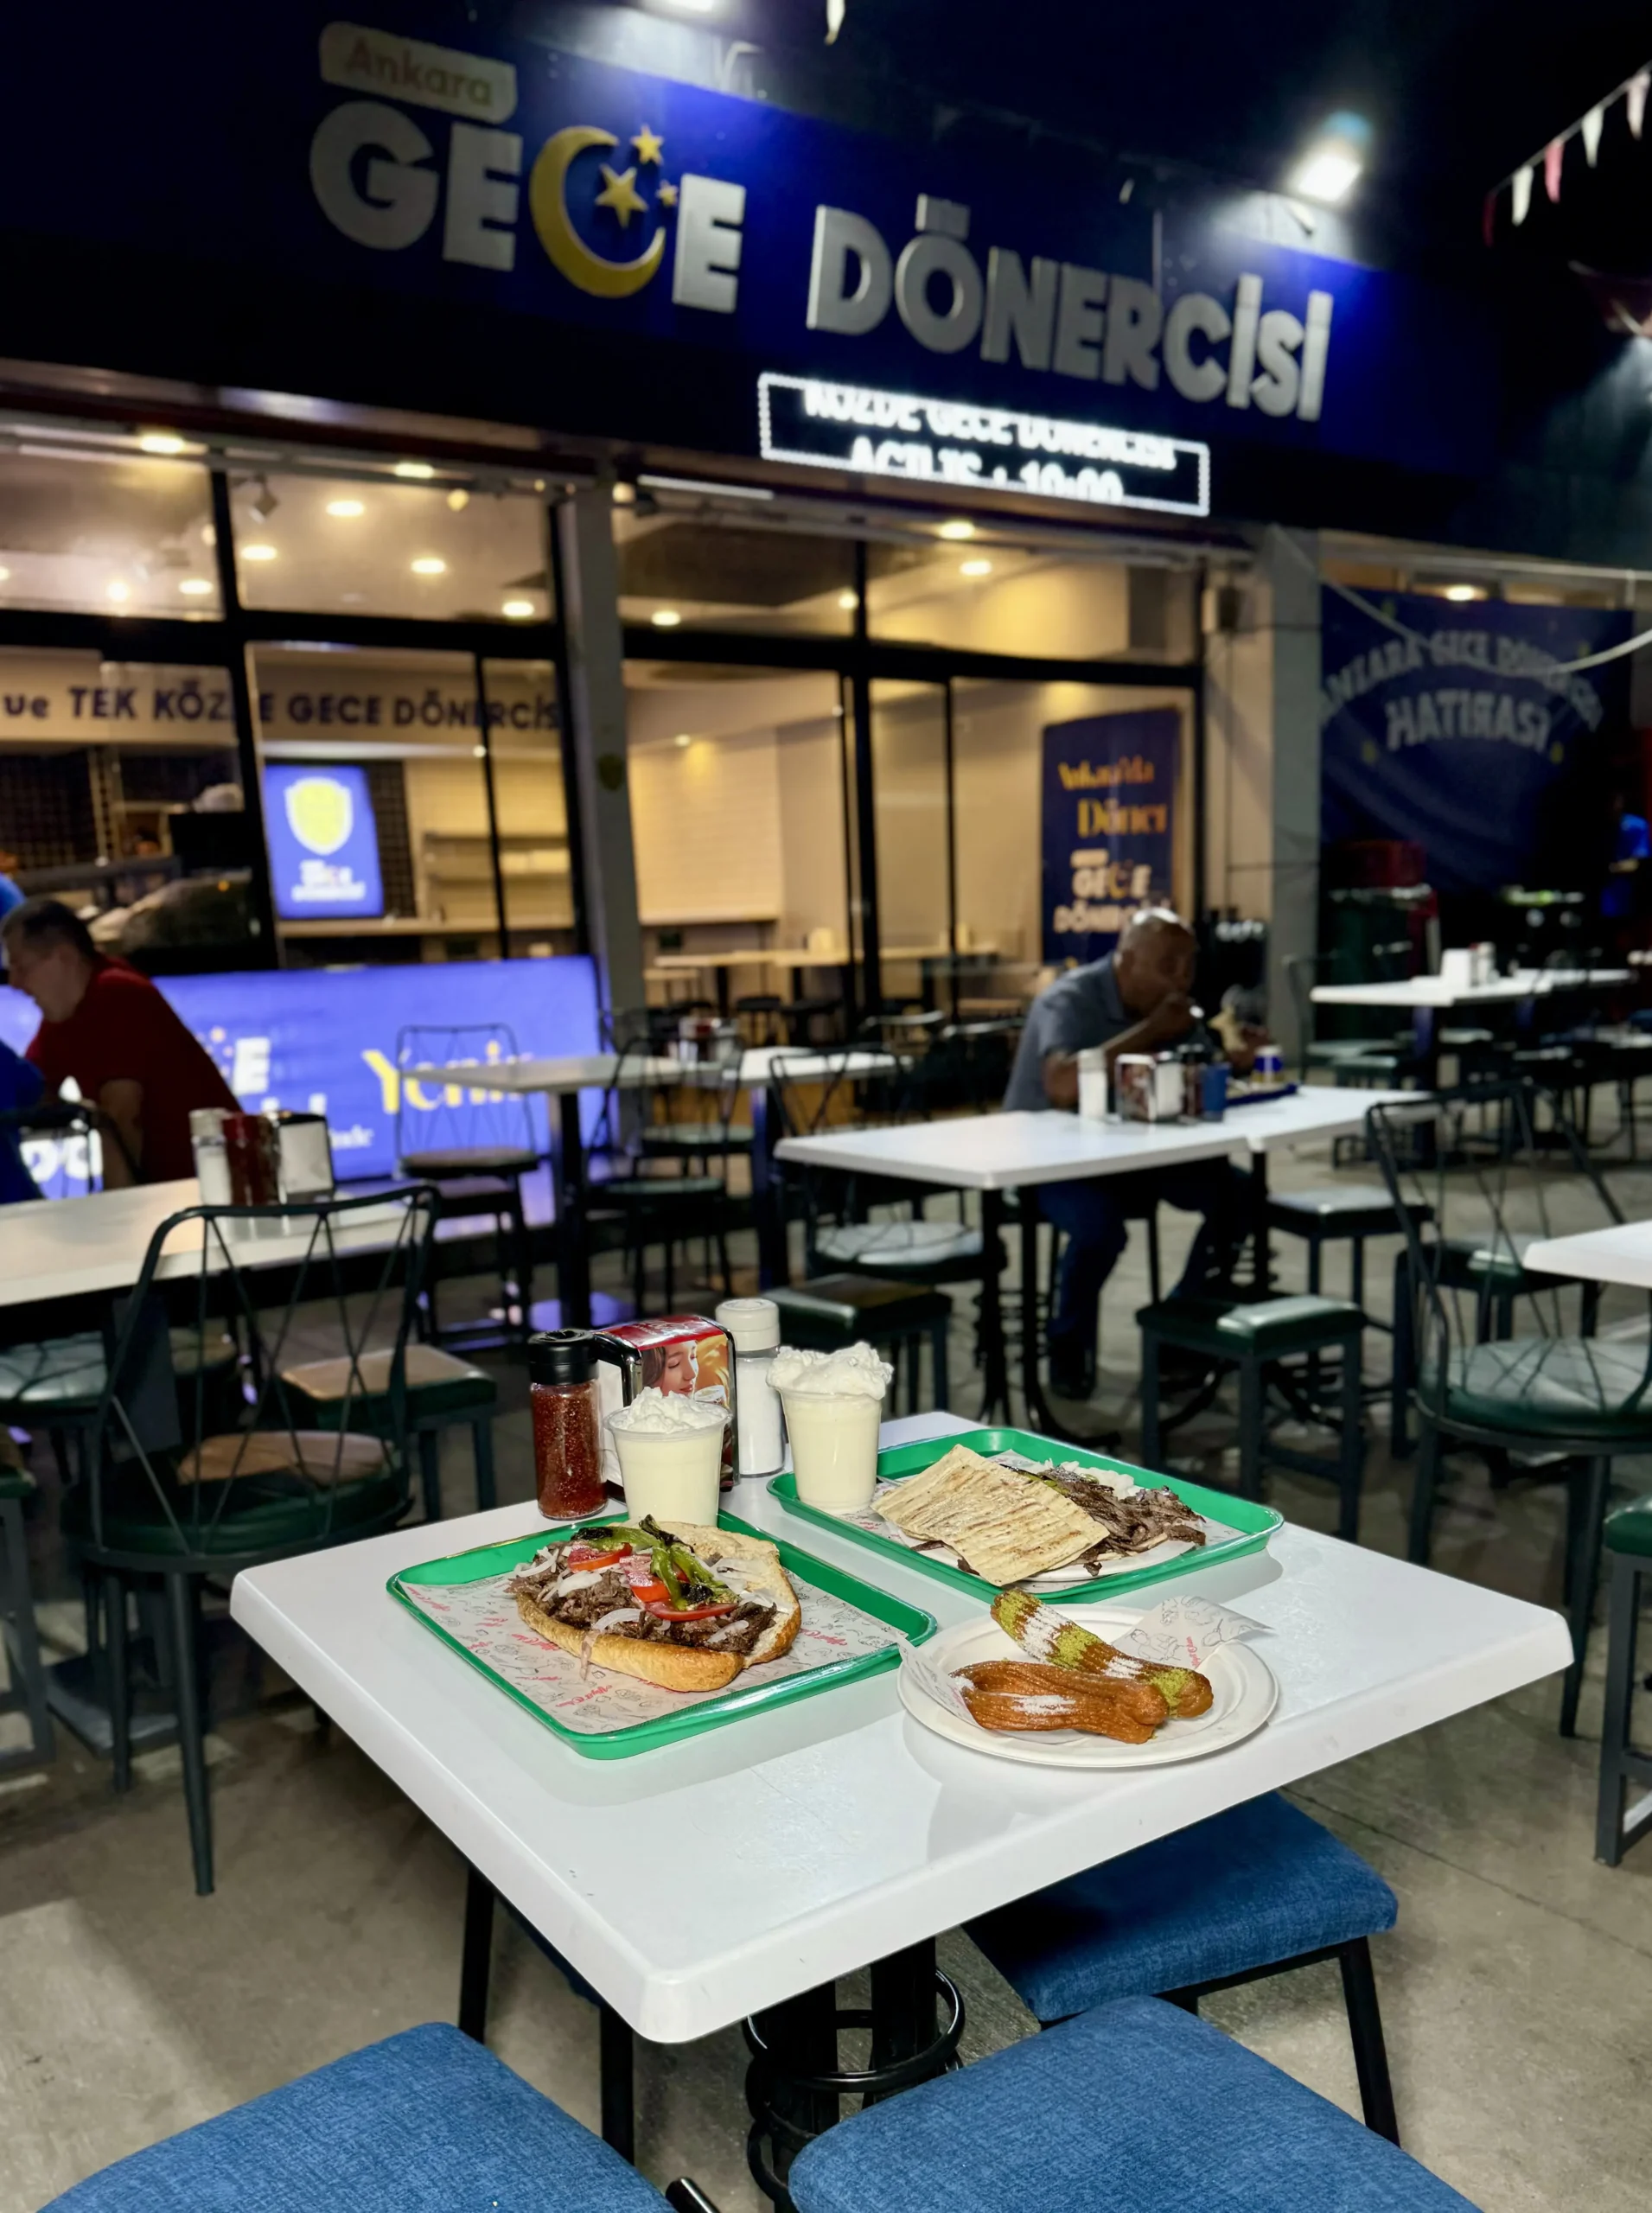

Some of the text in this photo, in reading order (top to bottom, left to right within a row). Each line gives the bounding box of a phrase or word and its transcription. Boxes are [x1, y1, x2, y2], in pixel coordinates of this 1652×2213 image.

[346, 36, 492, 107] Ankara
[309, 99, 746, 314] GECE
[69, 688, 137, 721] TEK
[154, 679, 273, 724] KÖZE
[288, 694, 381, 727] GECE
